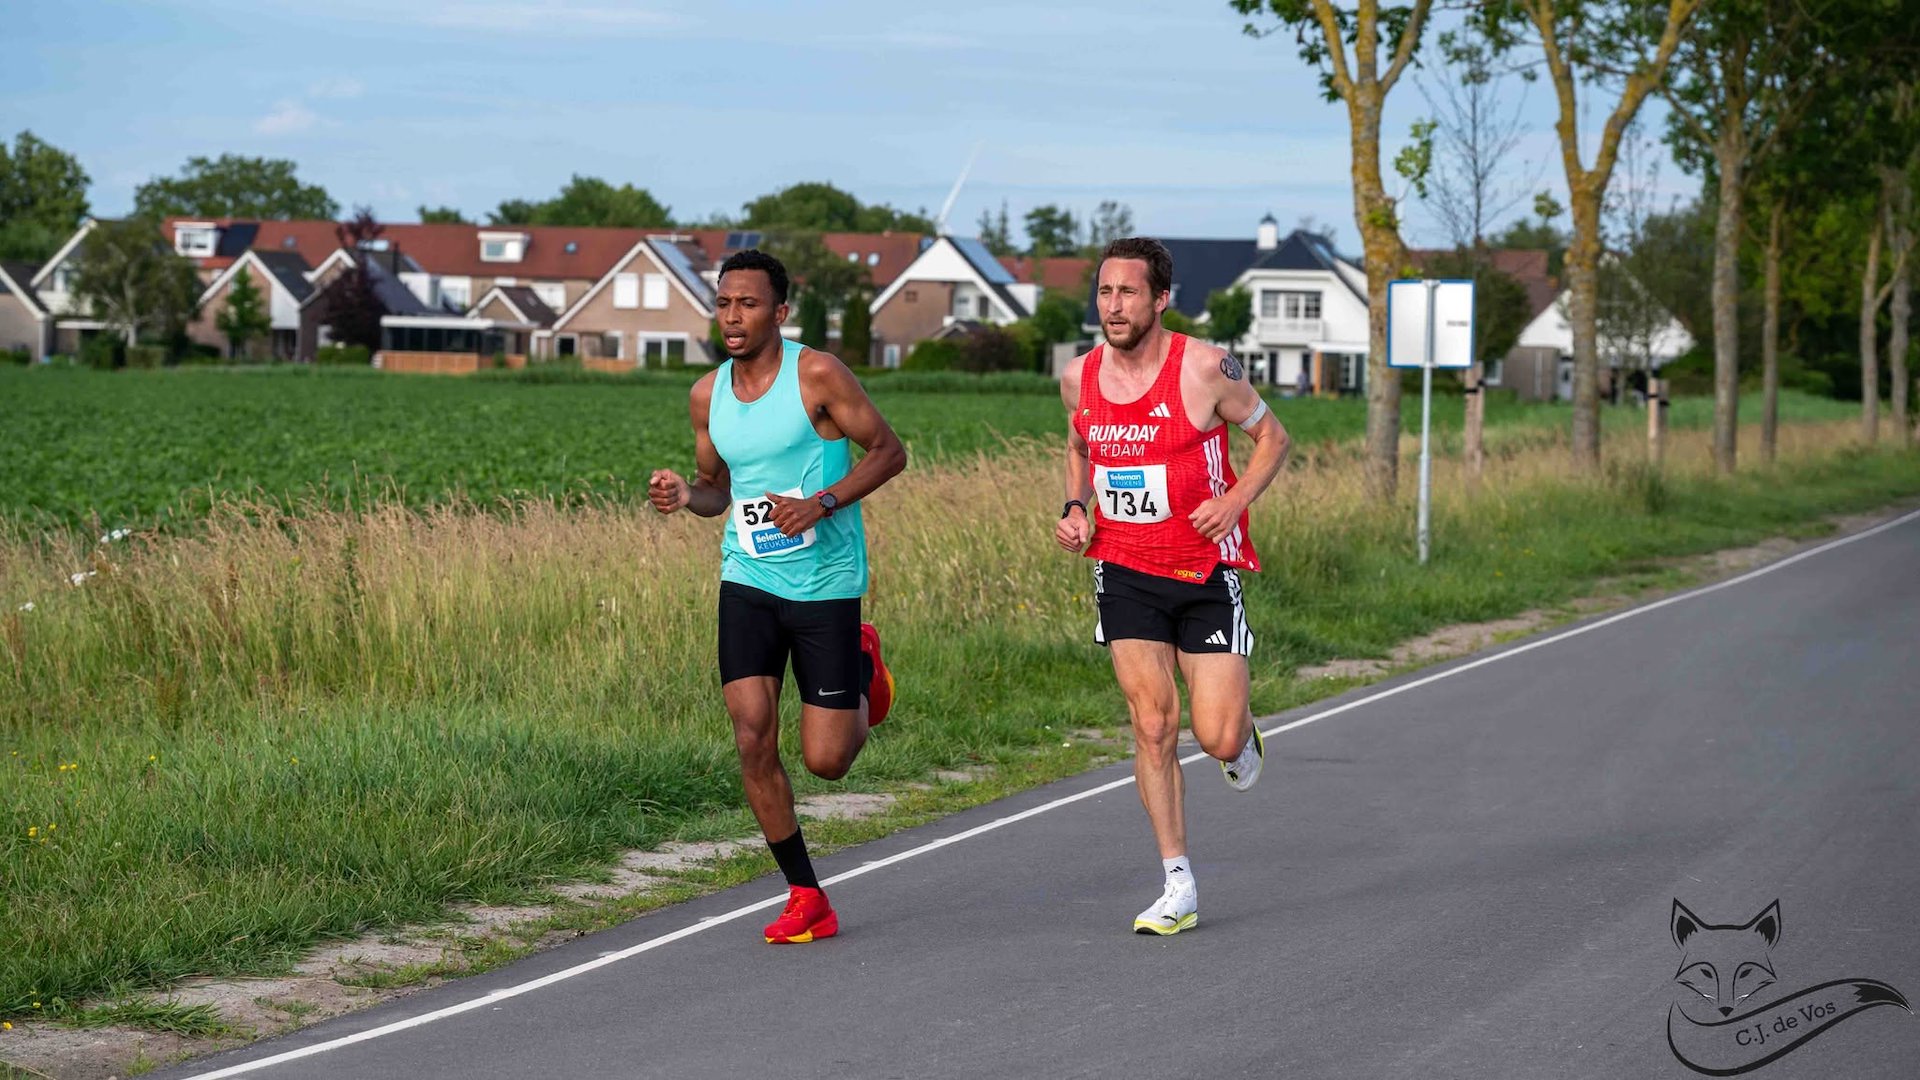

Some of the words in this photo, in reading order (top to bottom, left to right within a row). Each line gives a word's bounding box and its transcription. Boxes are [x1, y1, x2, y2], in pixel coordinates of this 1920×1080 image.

[1088, 424, 1160, 442] RUN2DAY
[1100, 443, 1146, 457] R'DAM
[1105, 489, 1158, 517] 734
[742, 501, 777, 526] 52
[757, 535, 800, 551] KEUKENS
